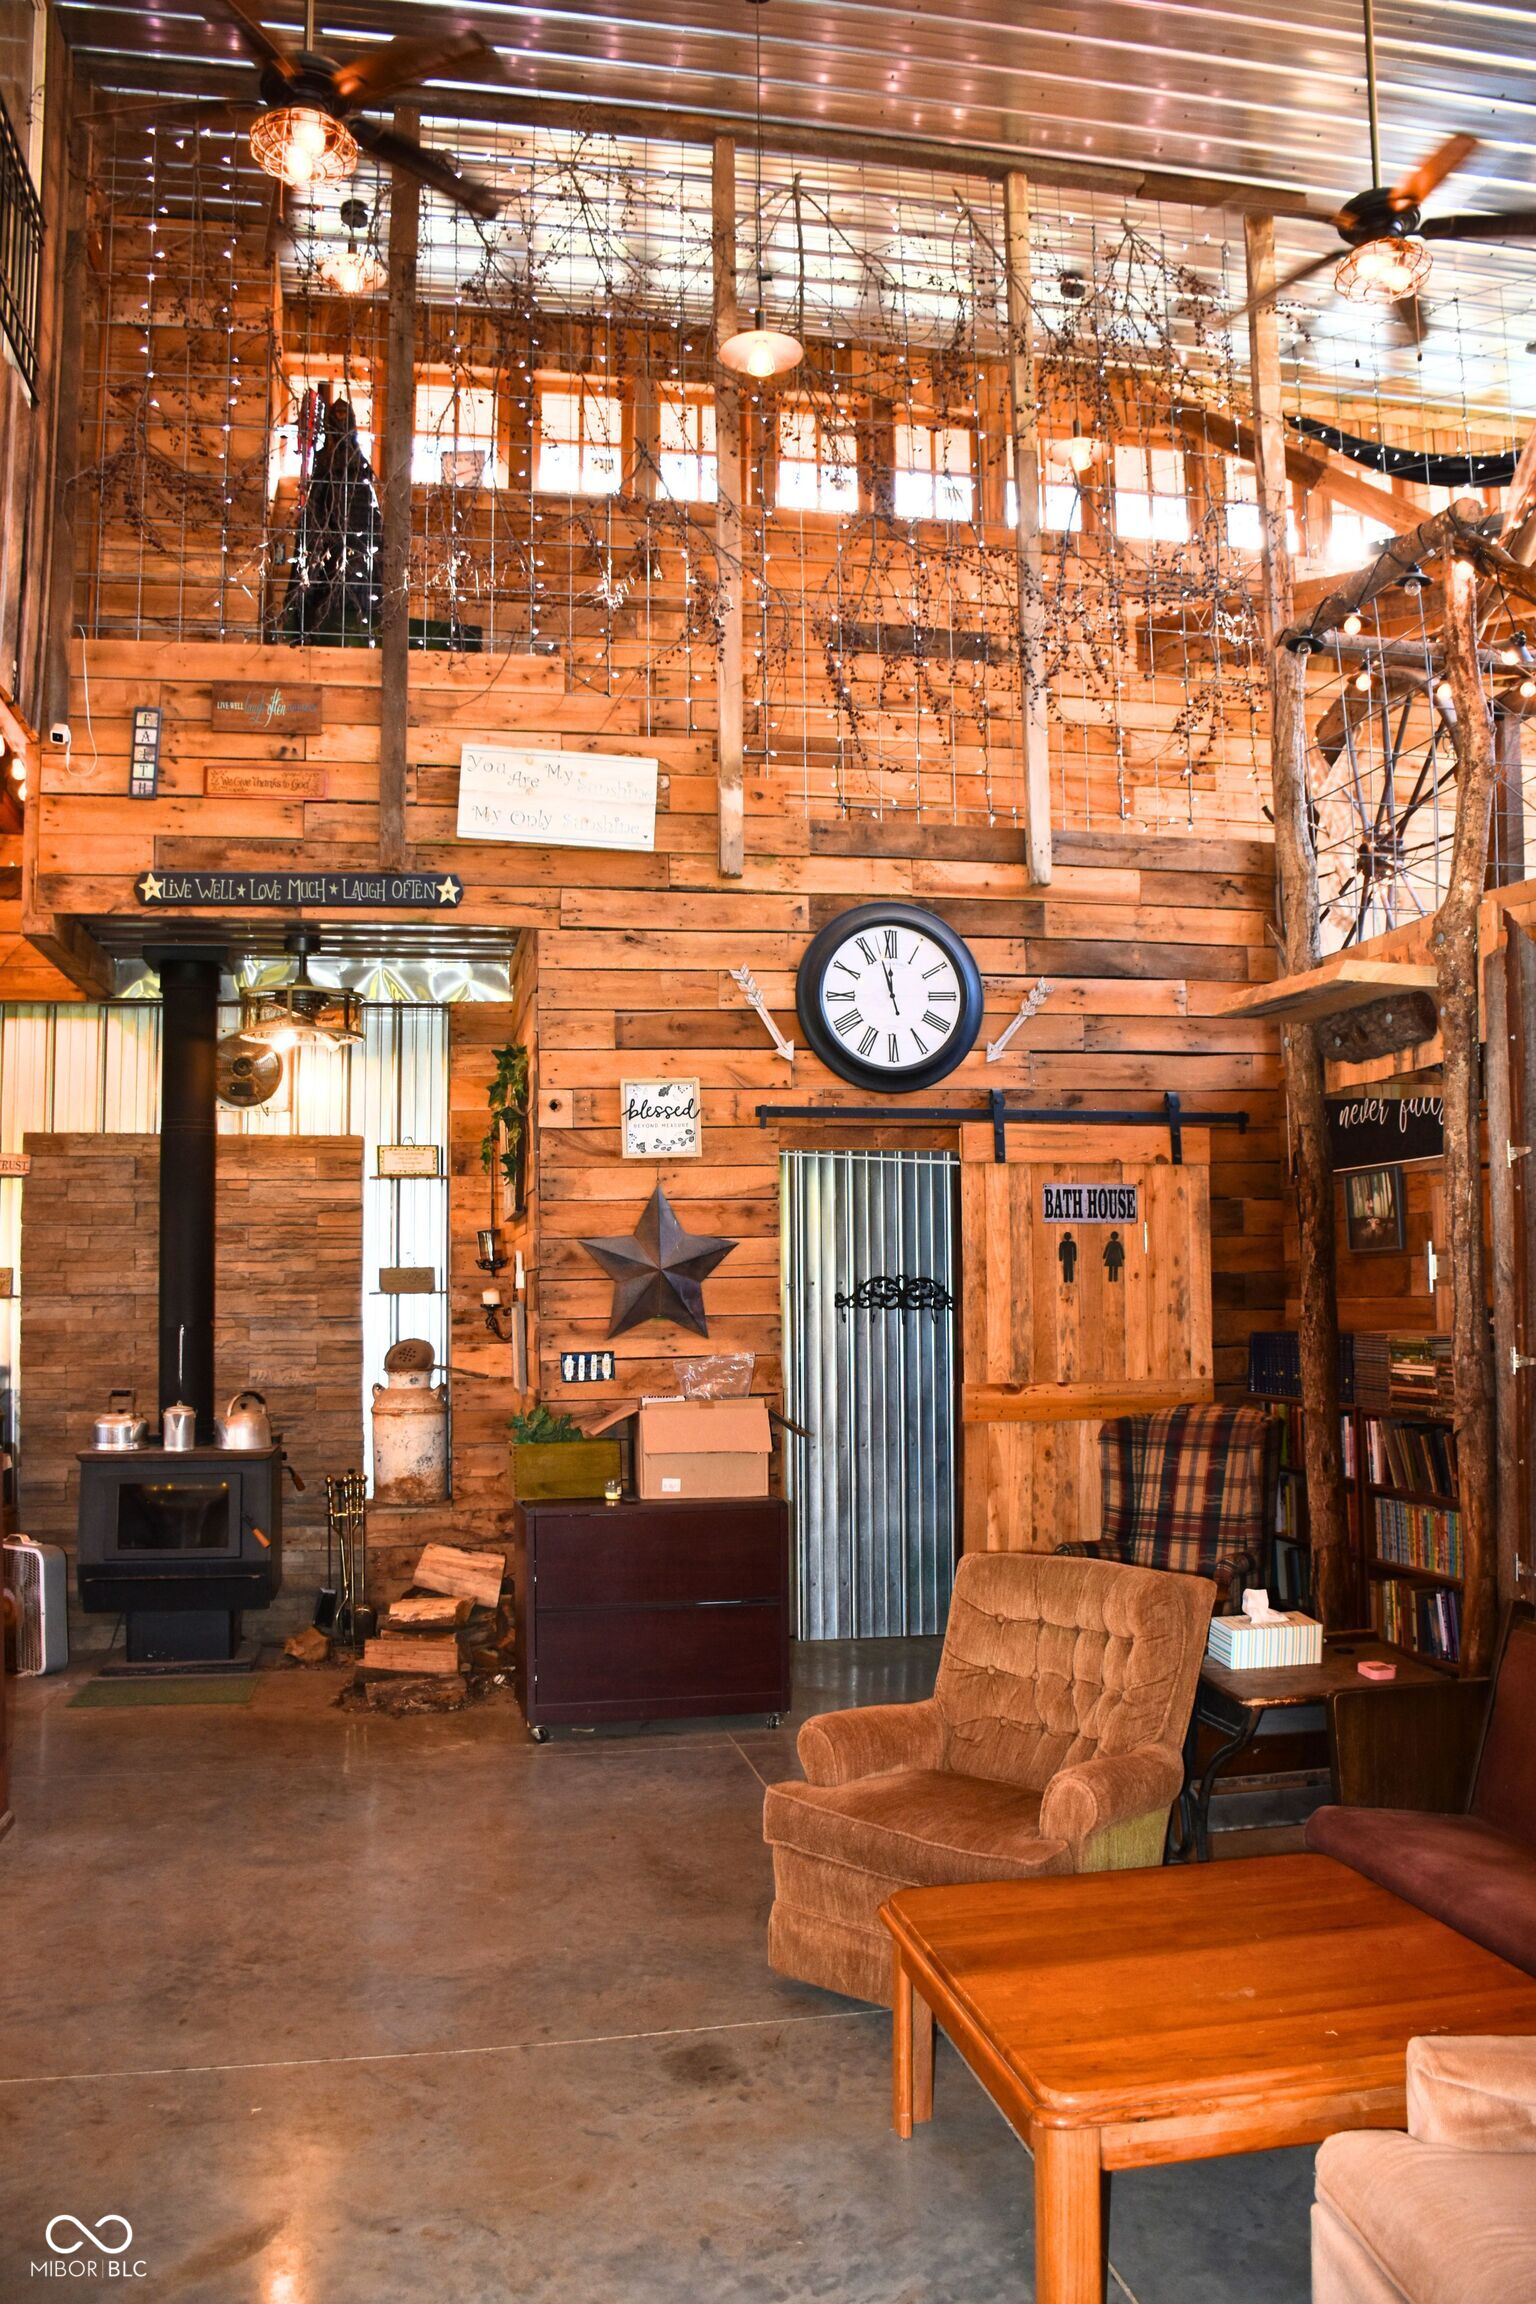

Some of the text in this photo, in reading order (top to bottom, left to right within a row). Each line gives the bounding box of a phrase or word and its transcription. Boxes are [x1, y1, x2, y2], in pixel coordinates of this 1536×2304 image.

[264, 687, 287, 728] often
[139, 713, 154, 794] FAITH
[221, 775, 312, 792] We Give Thanks to God
[466, 754, 507, 774] You
[506, 769, 541, 788] Are
[544, 763, 574, 784] My
[471, 804, 503, 826] My
[509, 809, 553, 831] Only
[194, 878, 237, 900] WELL
[249, 878, 282, 900] LOVE
[287, 878, 326, 903] MUCH
[341, 878, 387, 902] LAUGH
[391, 879, 437, 900] OFTEN
[883, 929, 898, 959] XII
[621, 1098, 701, 1121] blessed
[1339, 1098, 1390, 1129] never
[0, 1160, 29, 1171] RUST
[1044, 1188, 1136, 1220] BATH HOUSE
